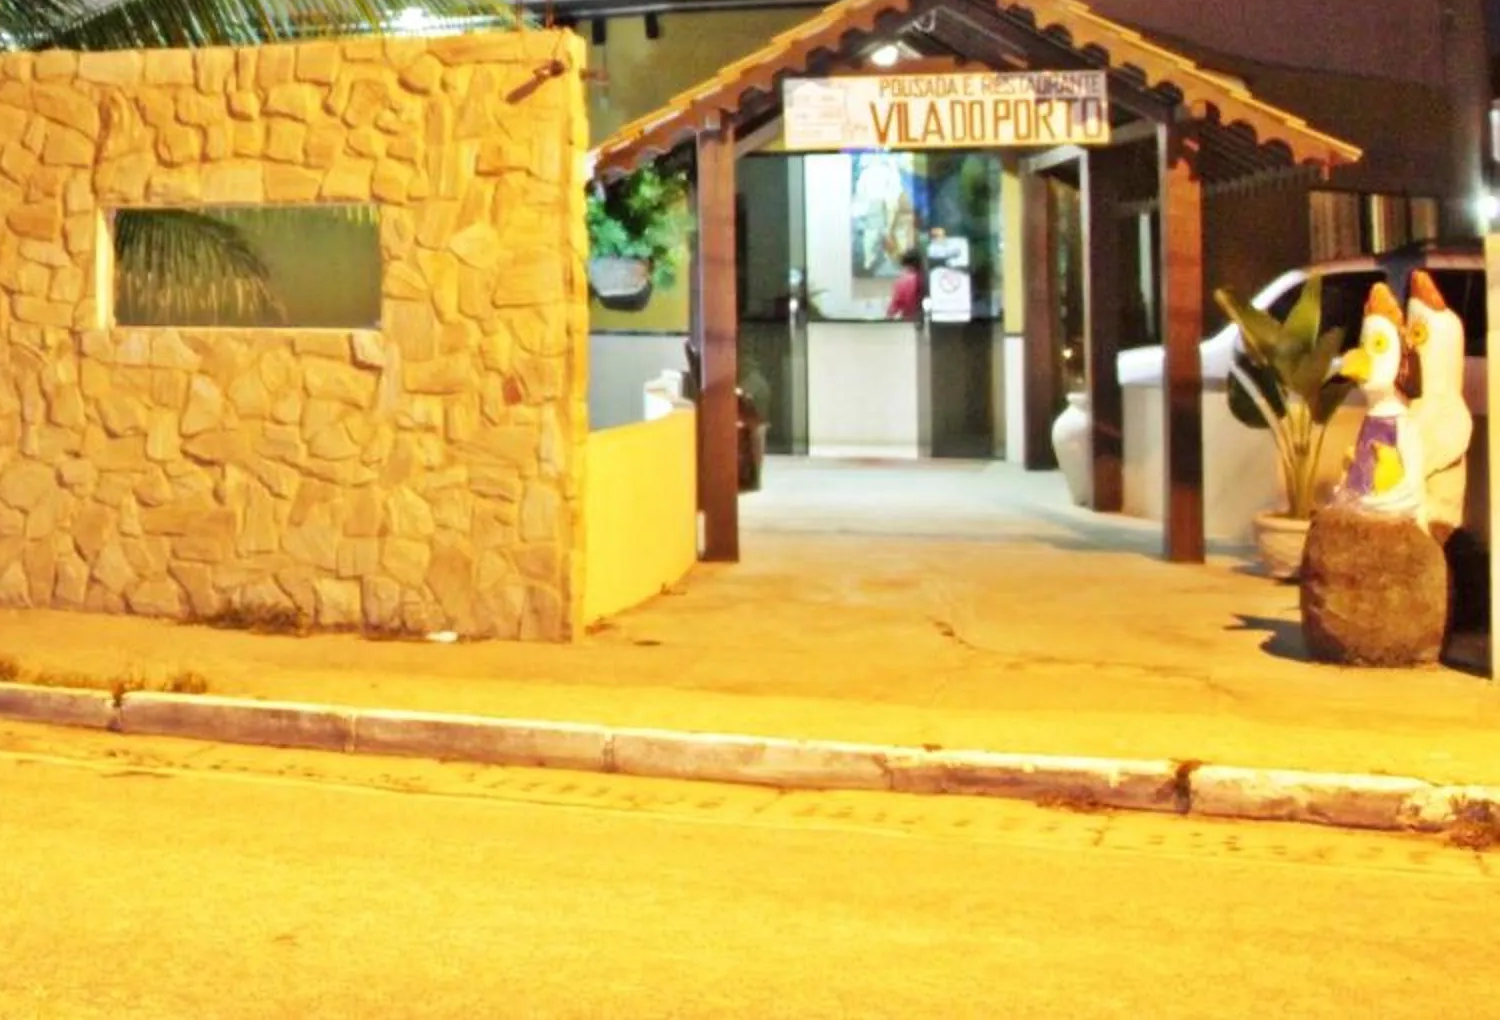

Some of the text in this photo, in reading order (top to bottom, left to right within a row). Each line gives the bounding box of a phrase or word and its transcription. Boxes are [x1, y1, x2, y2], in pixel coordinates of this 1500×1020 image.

[879, 72, 1102, 97] POUSADA E RESTAURANTE
[869, 97, 1102, 144] VILA DO PORTO
